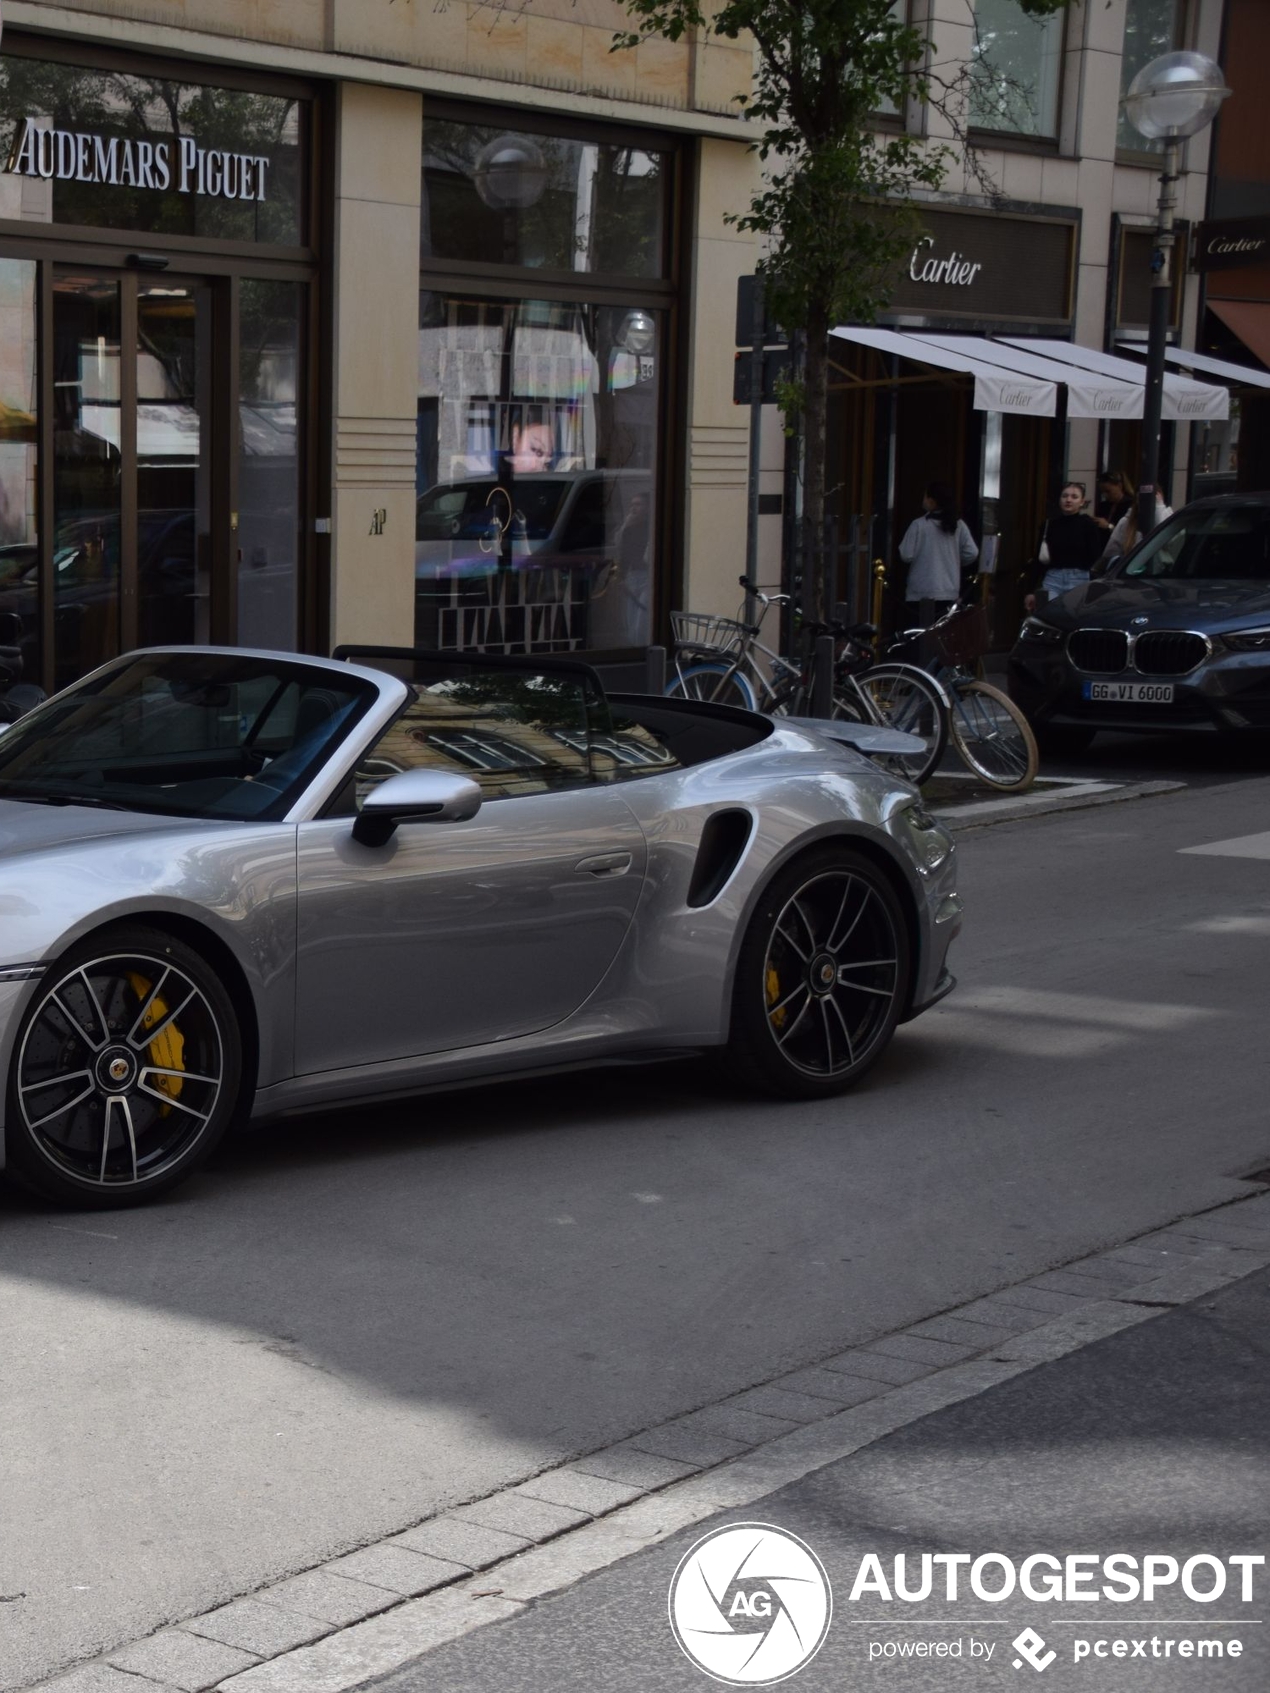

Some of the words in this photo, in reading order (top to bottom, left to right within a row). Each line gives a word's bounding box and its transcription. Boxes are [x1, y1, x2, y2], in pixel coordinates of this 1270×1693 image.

[11, 117, 170, 191] AUDEMARS
[179, 136, 270, 202] PIGUET
[1207, 236, 1266, 254] Cartier
[909, 236, 982, 286] Cartier
[999, 383, 1033, 407] Cartier
[1093, 389, 1124, 412] Cartier
[1177, 392, 1209, 414] Cartier
[1092, 684, 1108, 699] GG
[1118, 685, 1133, 700] VI
[1138, 686, 1171, 701] 6000
